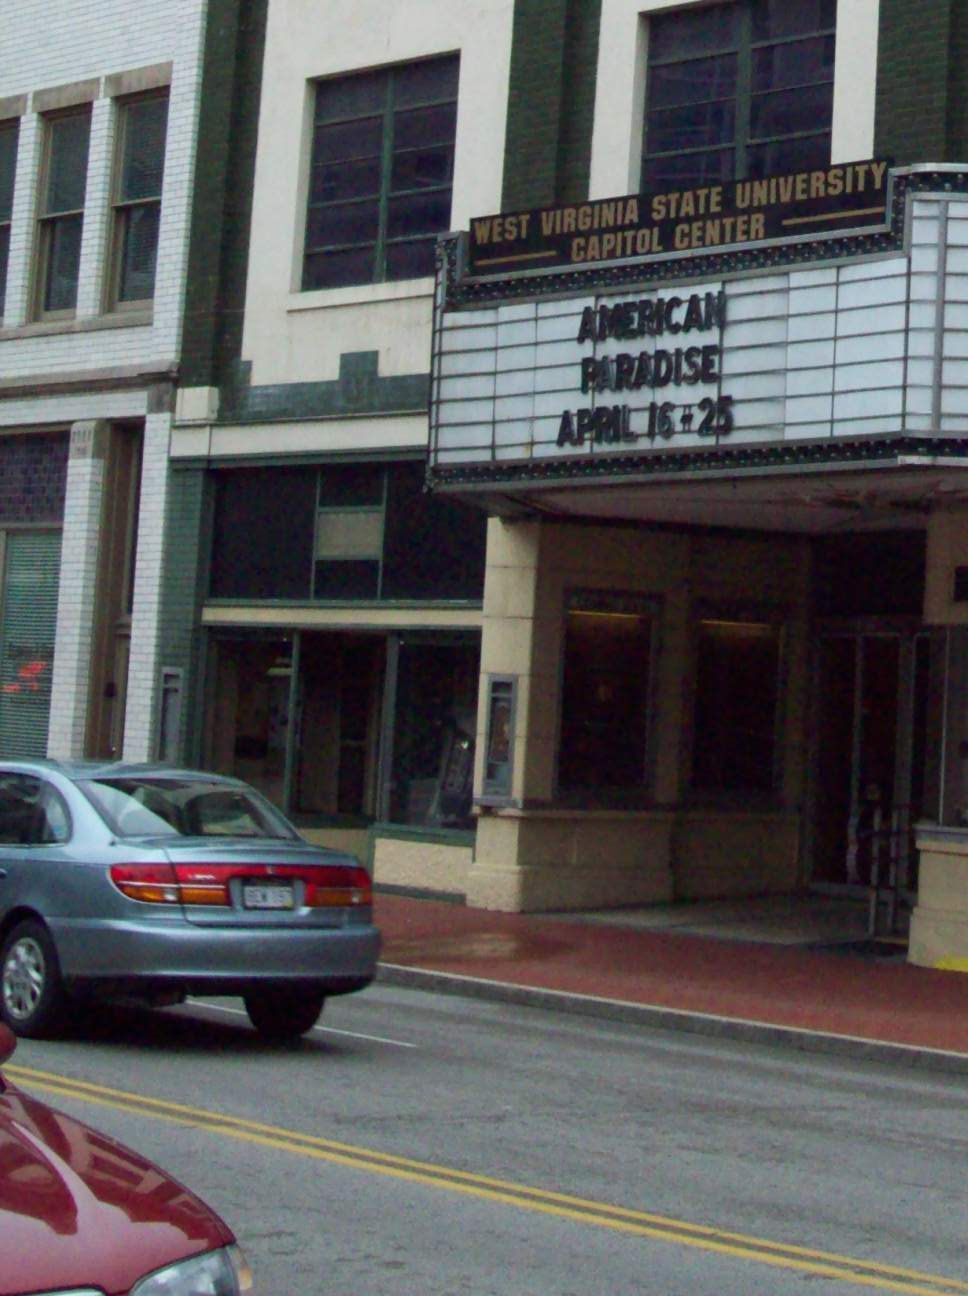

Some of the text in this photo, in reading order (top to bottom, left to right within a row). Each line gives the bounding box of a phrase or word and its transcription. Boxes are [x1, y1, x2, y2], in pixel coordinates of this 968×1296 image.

[474, 161, 887, 245] WEST VIRGINIA STATE UNIVERSITY
[571, 213, 765, 262] CAPITOL CENTER
[577, 290, 728, 344] AMERICAN
[581, 344, 721, 394] PARADISE
[556, 404, 639, 447] APRIL
